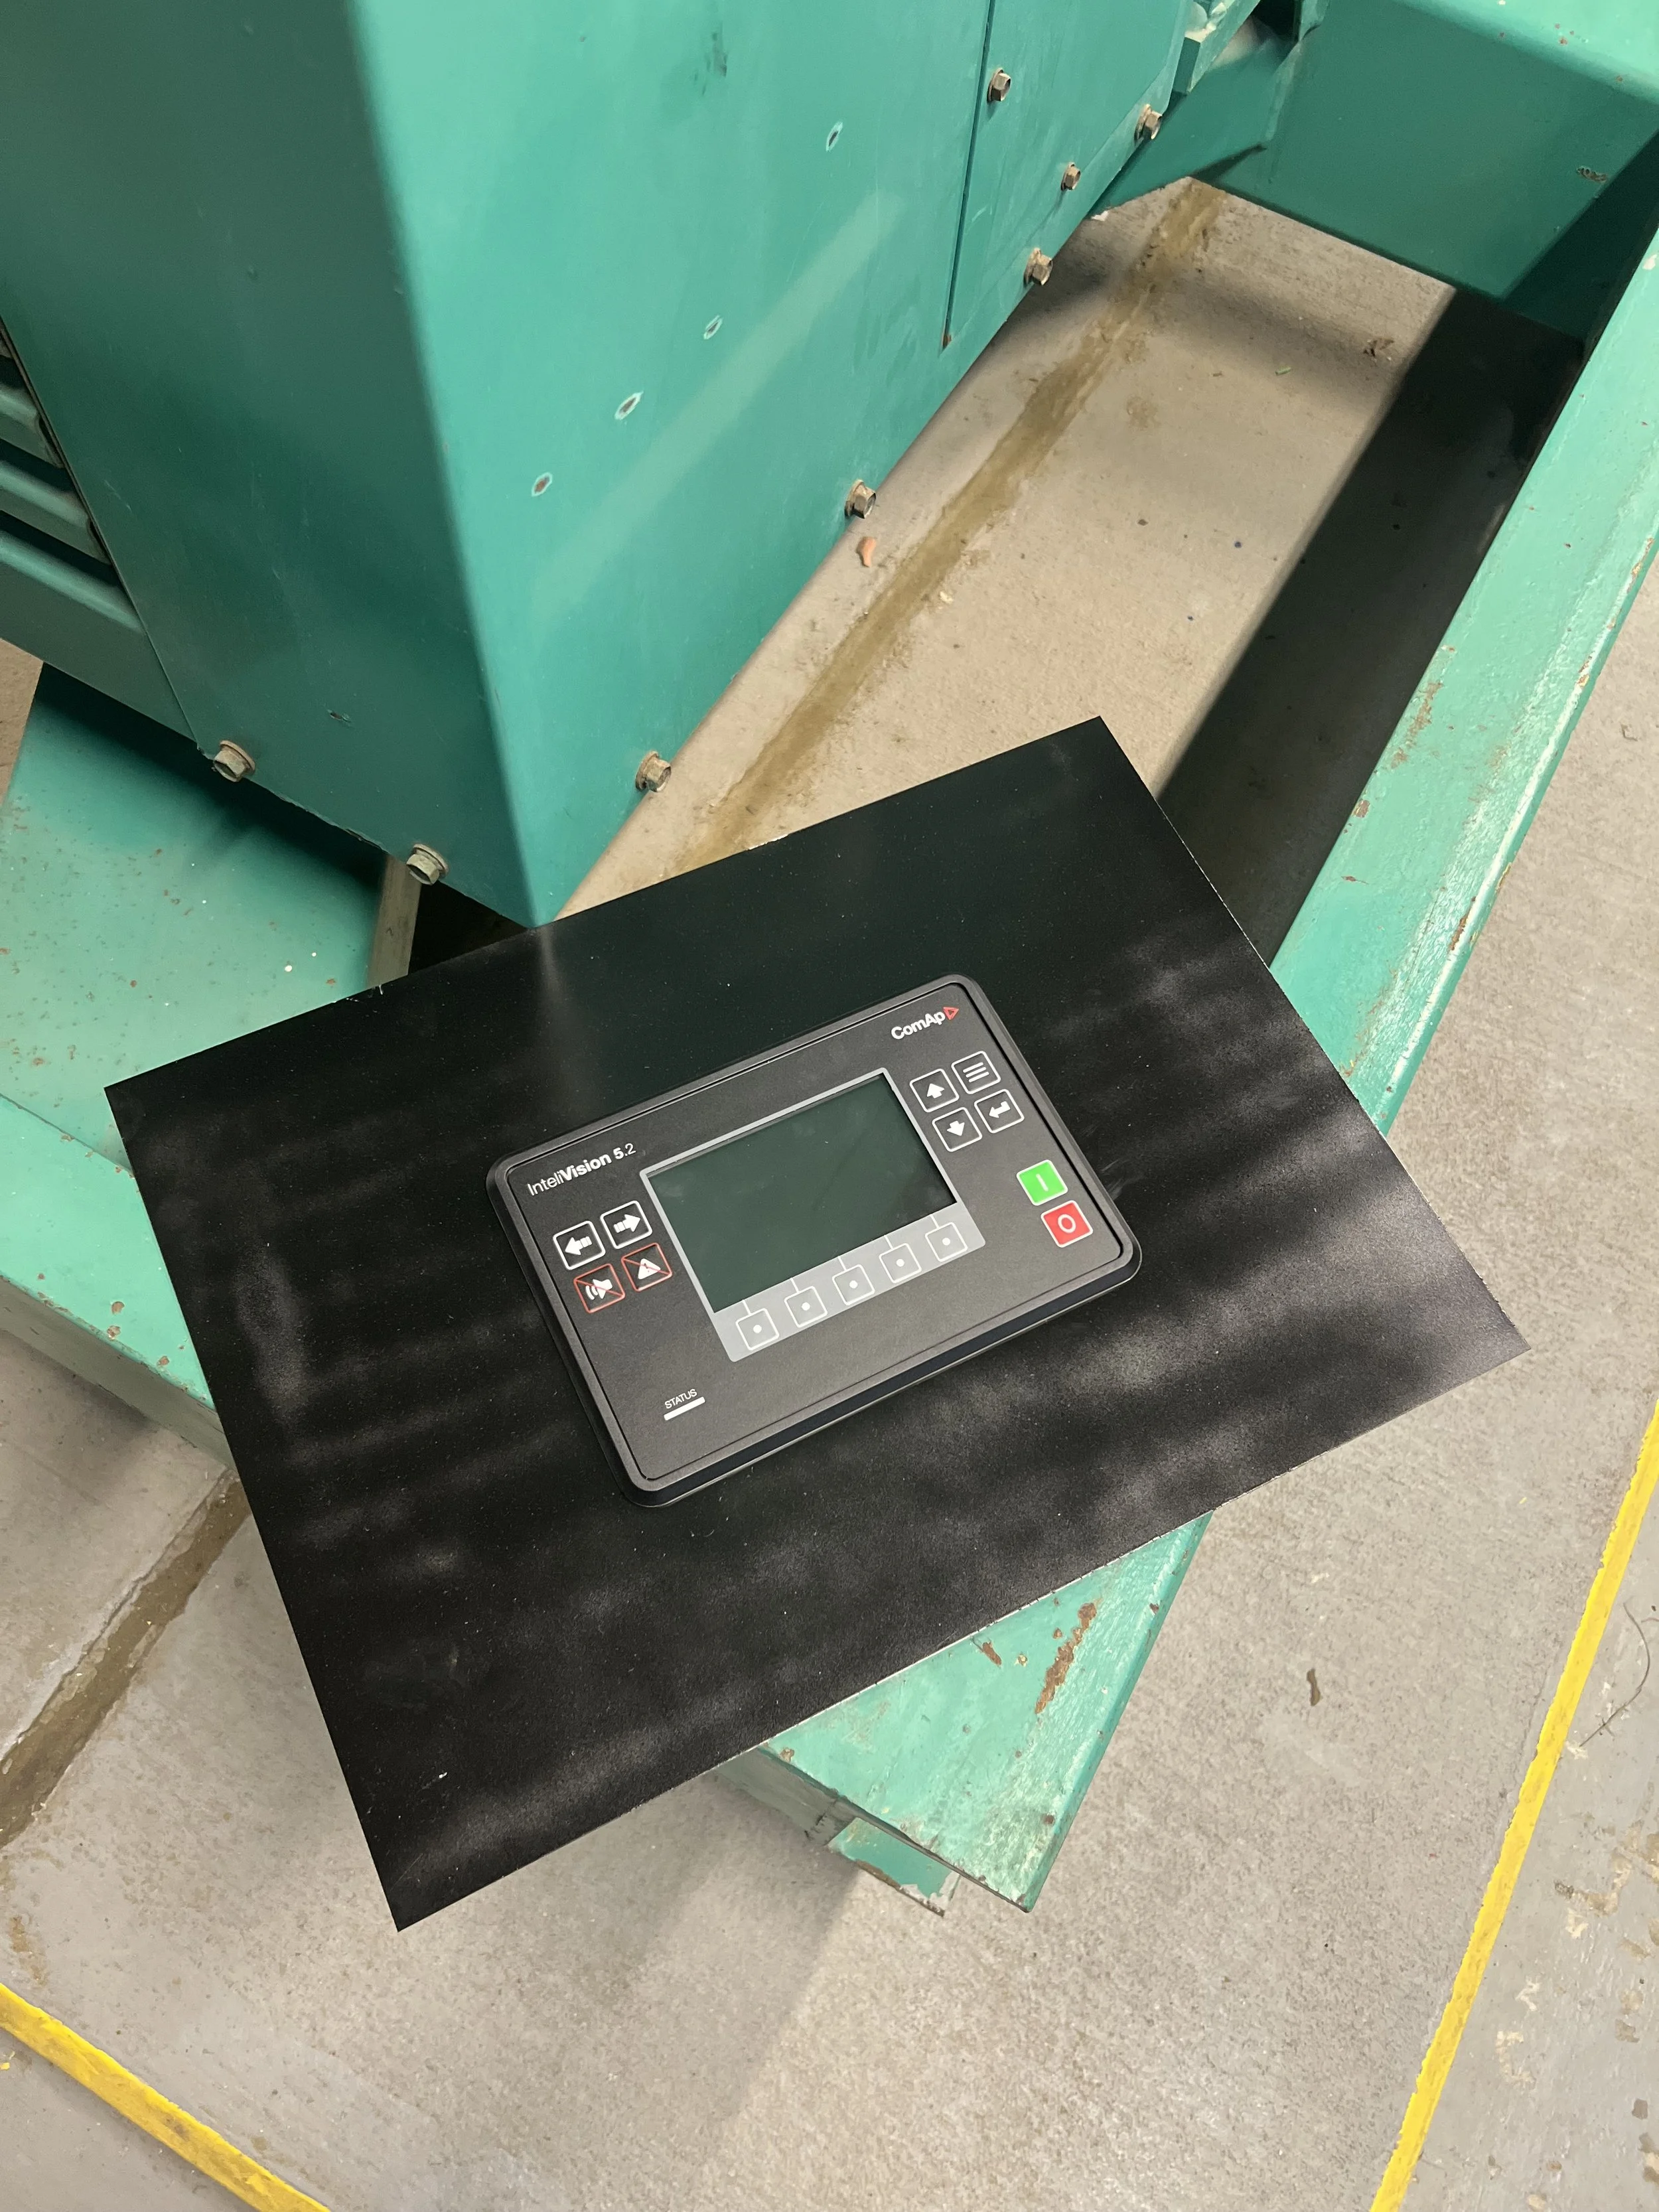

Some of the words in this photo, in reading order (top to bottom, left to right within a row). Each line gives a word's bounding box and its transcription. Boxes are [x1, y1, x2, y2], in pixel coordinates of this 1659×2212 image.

[891, 1011, 946, 1040] ComAp
[527, 1153, 613, 1196] InteliVision
[613, 1143, 636, 1160] 5.2
[664, 1388, 697, 1409] STATUS
